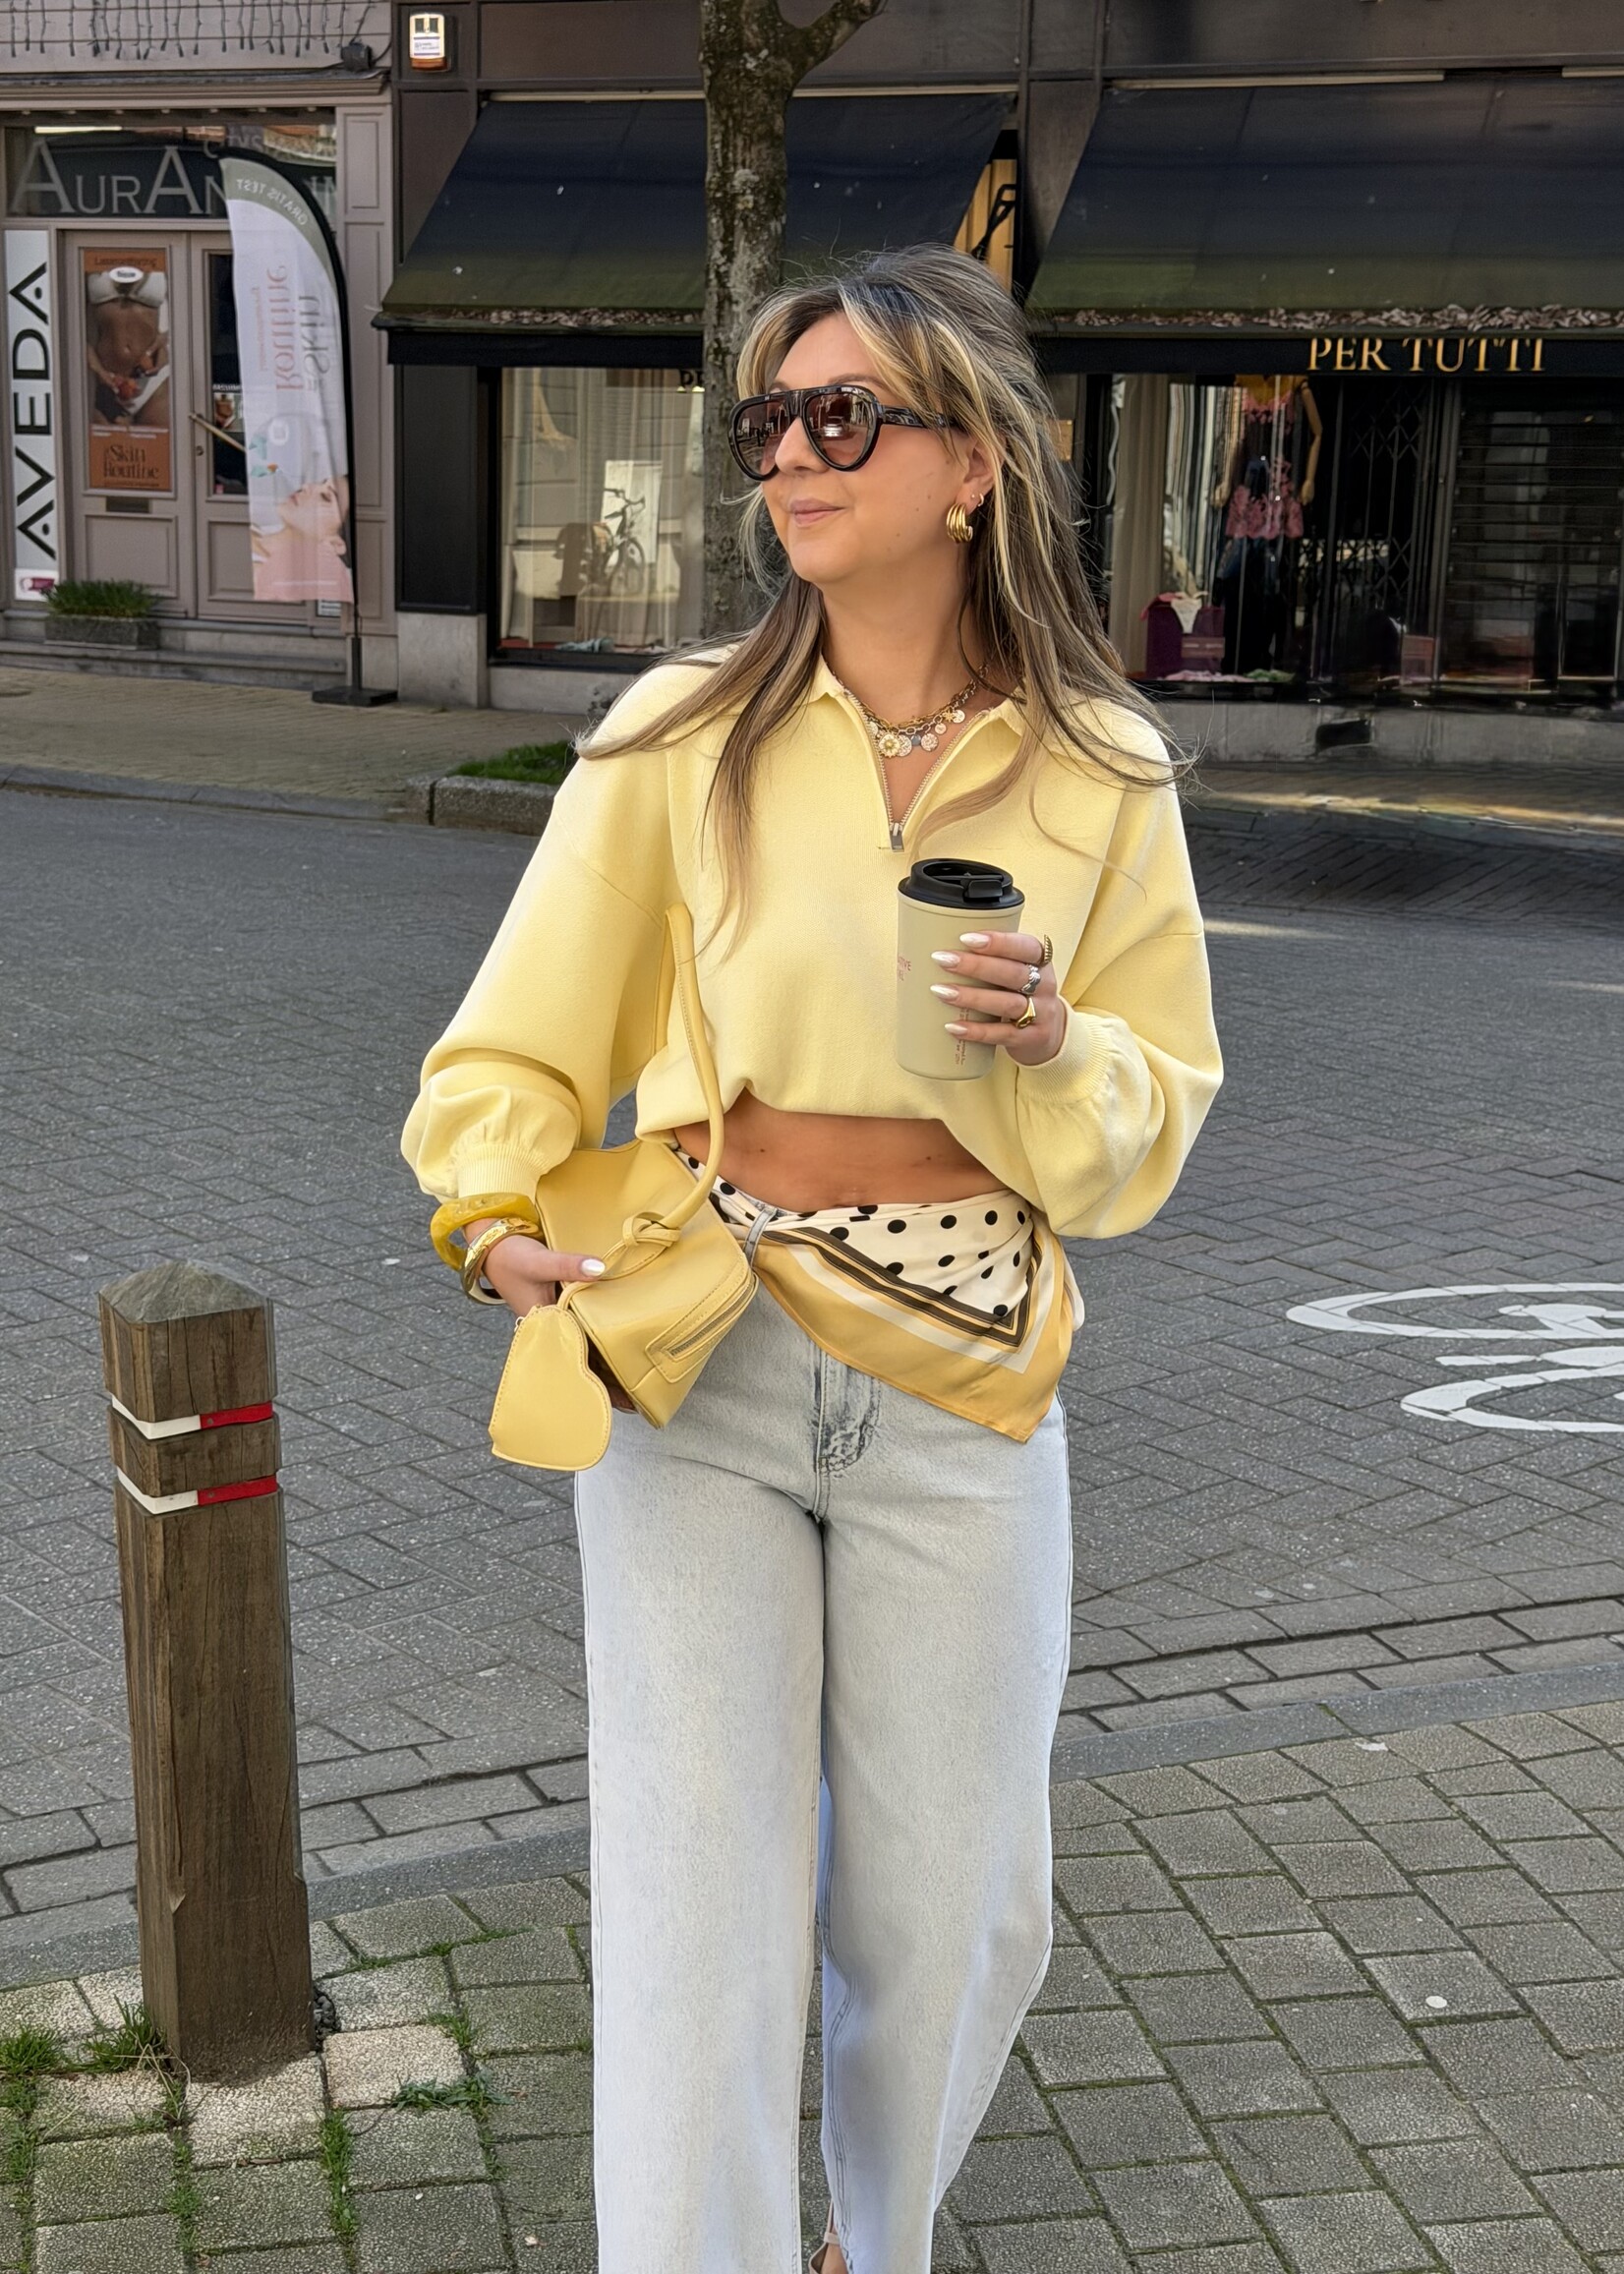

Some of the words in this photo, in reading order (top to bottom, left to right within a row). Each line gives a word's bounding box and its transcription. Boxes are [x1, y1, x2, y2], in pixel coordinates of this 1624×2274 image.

[9, 262, 56, 560] AVEDA
[1307, 338, 1391, 371] PER
[1402, 338, 1545, 373] TUTTI
